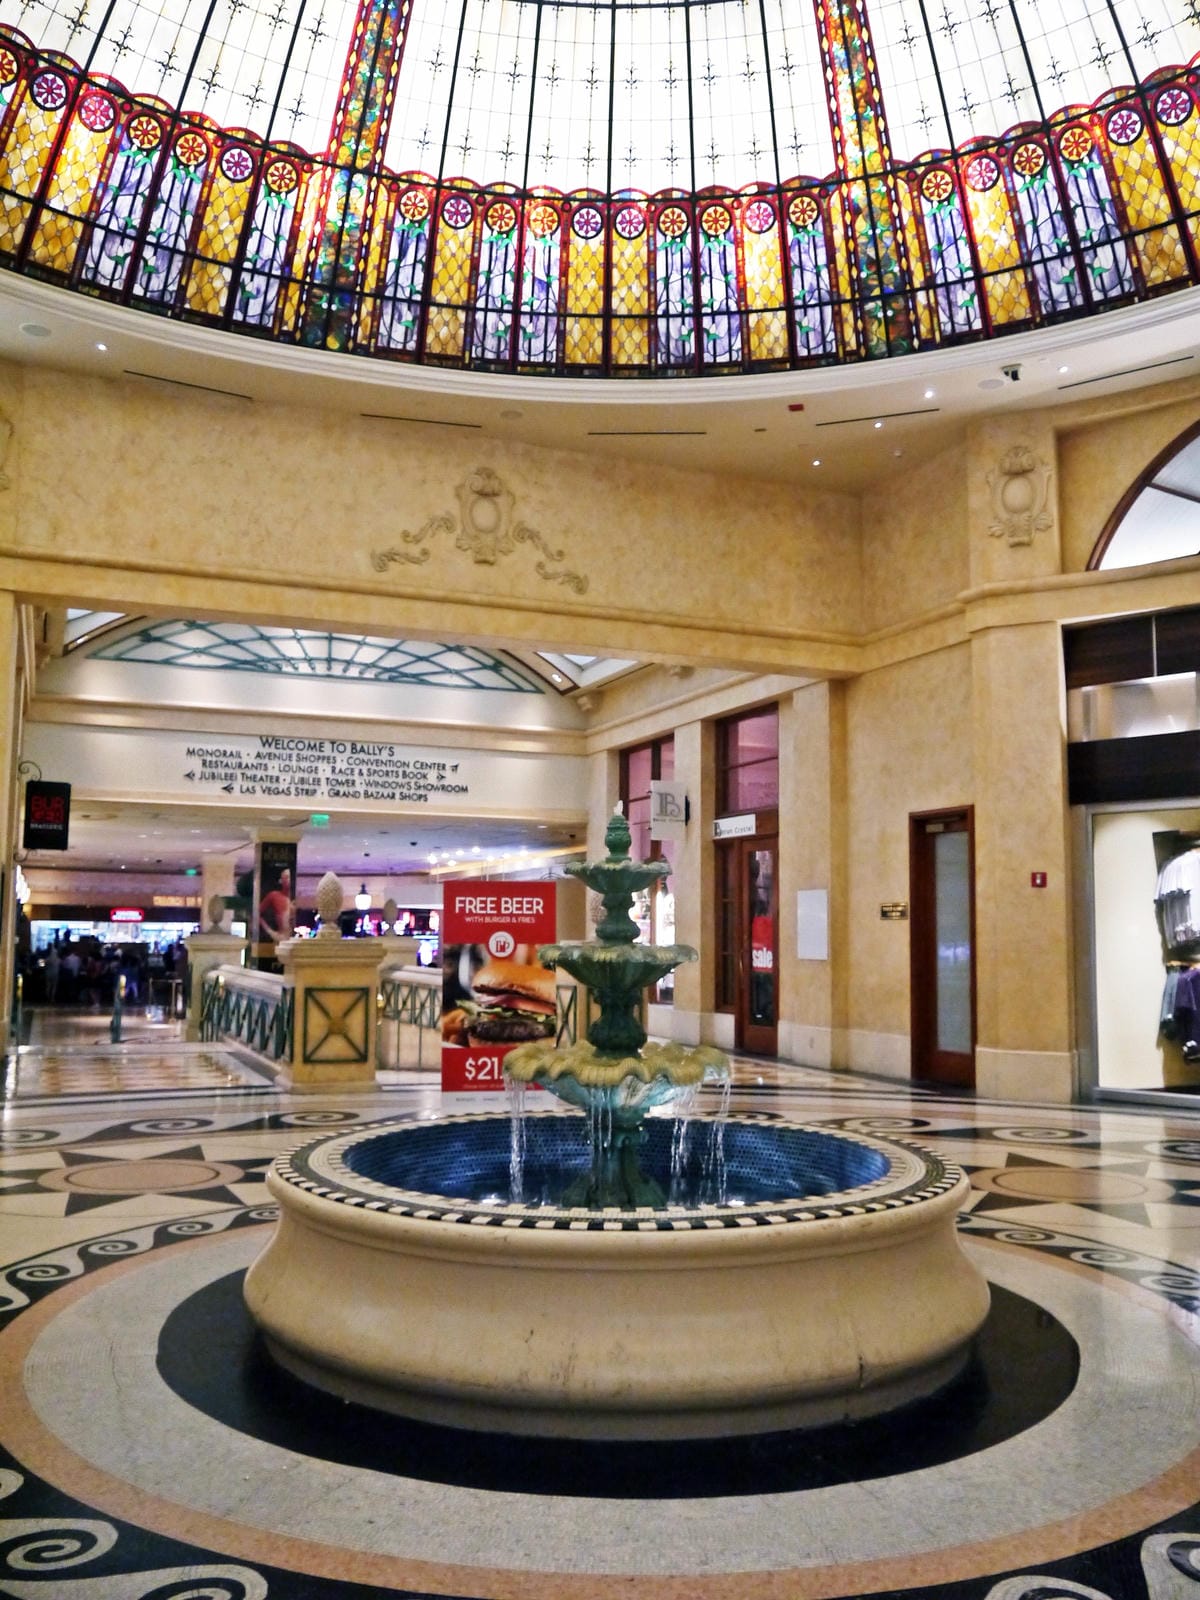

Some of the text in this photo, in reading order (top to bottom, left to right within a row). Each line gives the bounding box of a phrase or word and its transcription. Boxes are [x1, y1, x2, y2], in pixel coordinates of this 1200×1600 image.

[259, 735, 395, 757] WELCOME TO BALLY'S
[186, 747, 447, 771] MONORAIL AVENUE SHOPPES CONVENTION CENTER
[201, 759, 429, 780] RESTAURANTS LOUNGE RACE & SPORTS BOOK
[240, 772, 280, 783] THEATER
[288, 774, 322, 786] JUBILEE
[325, 777, 356, 787] TOWER
[364, 779, 412, 791] WINDOWS
[413, 782, 469, 793] SHOWROOM
[240, 784, 428, 802] LAS VEGAS STRIP GRAND BAZAAR SHOPS
[455, 896, 544, 915] FREE BEER
[464, 916, 536, 924] WITH BURGER & FRIES
[752, 947, 773, 968] sale
[464, 1057, 504, 1081] $21.
